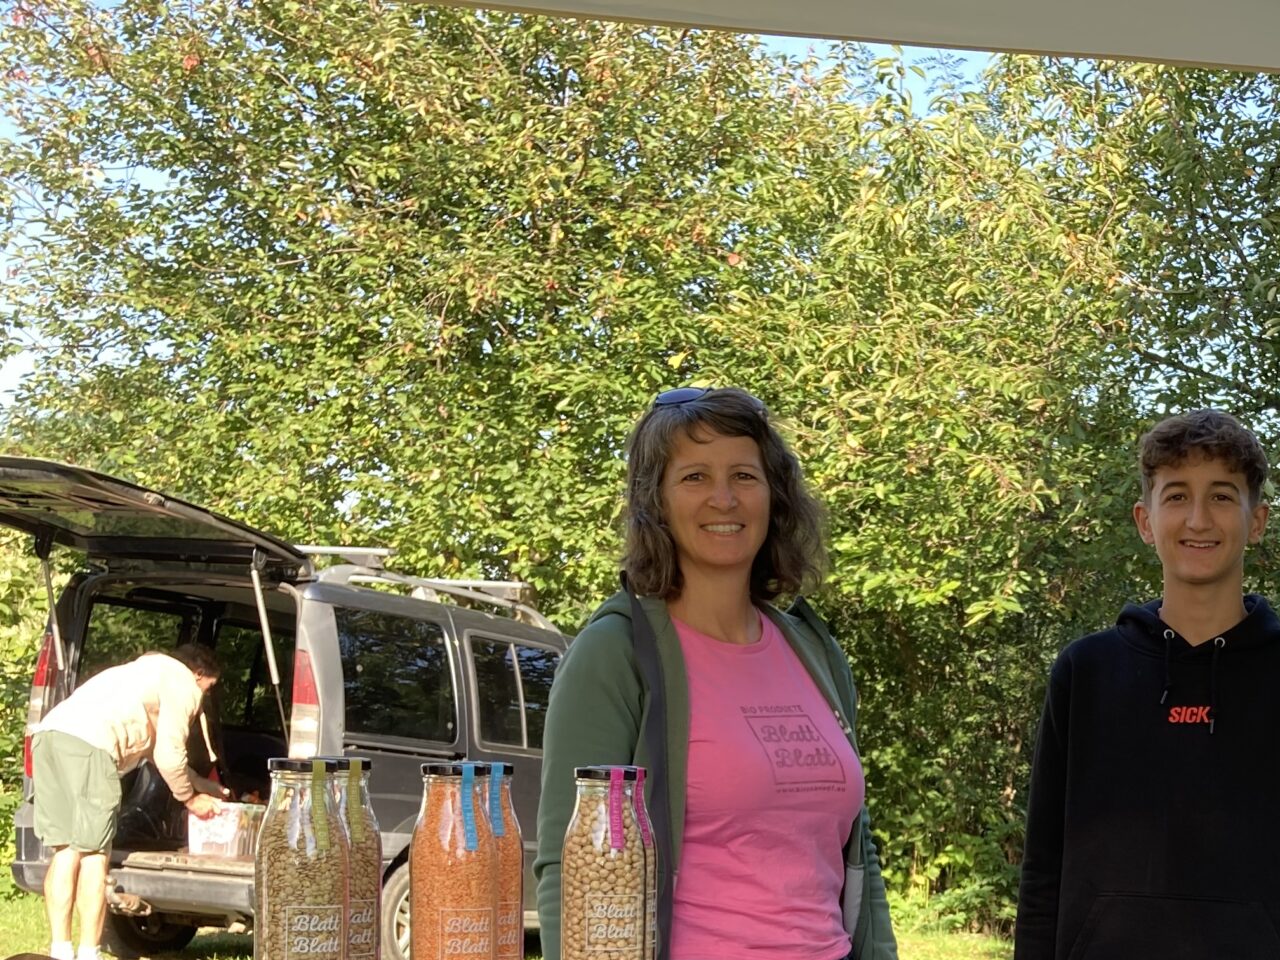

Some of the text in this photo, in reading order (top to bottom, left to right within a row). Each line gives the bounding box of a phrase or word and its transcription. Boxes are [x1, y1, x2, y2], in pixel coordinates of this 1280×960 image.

[761, 724, 820, 742] Blatt
[775, 748, 836, 768] Blatt
[591, 903, 636, 918] Blatt
[292, 915, 340, 932] Blatt
[444, 917, 489, 933] Blatt
[591, 924, 635, 939] Blatt
[292, 937, 340, 953] Blatt
[445, 939, 489, 954] Blatt
